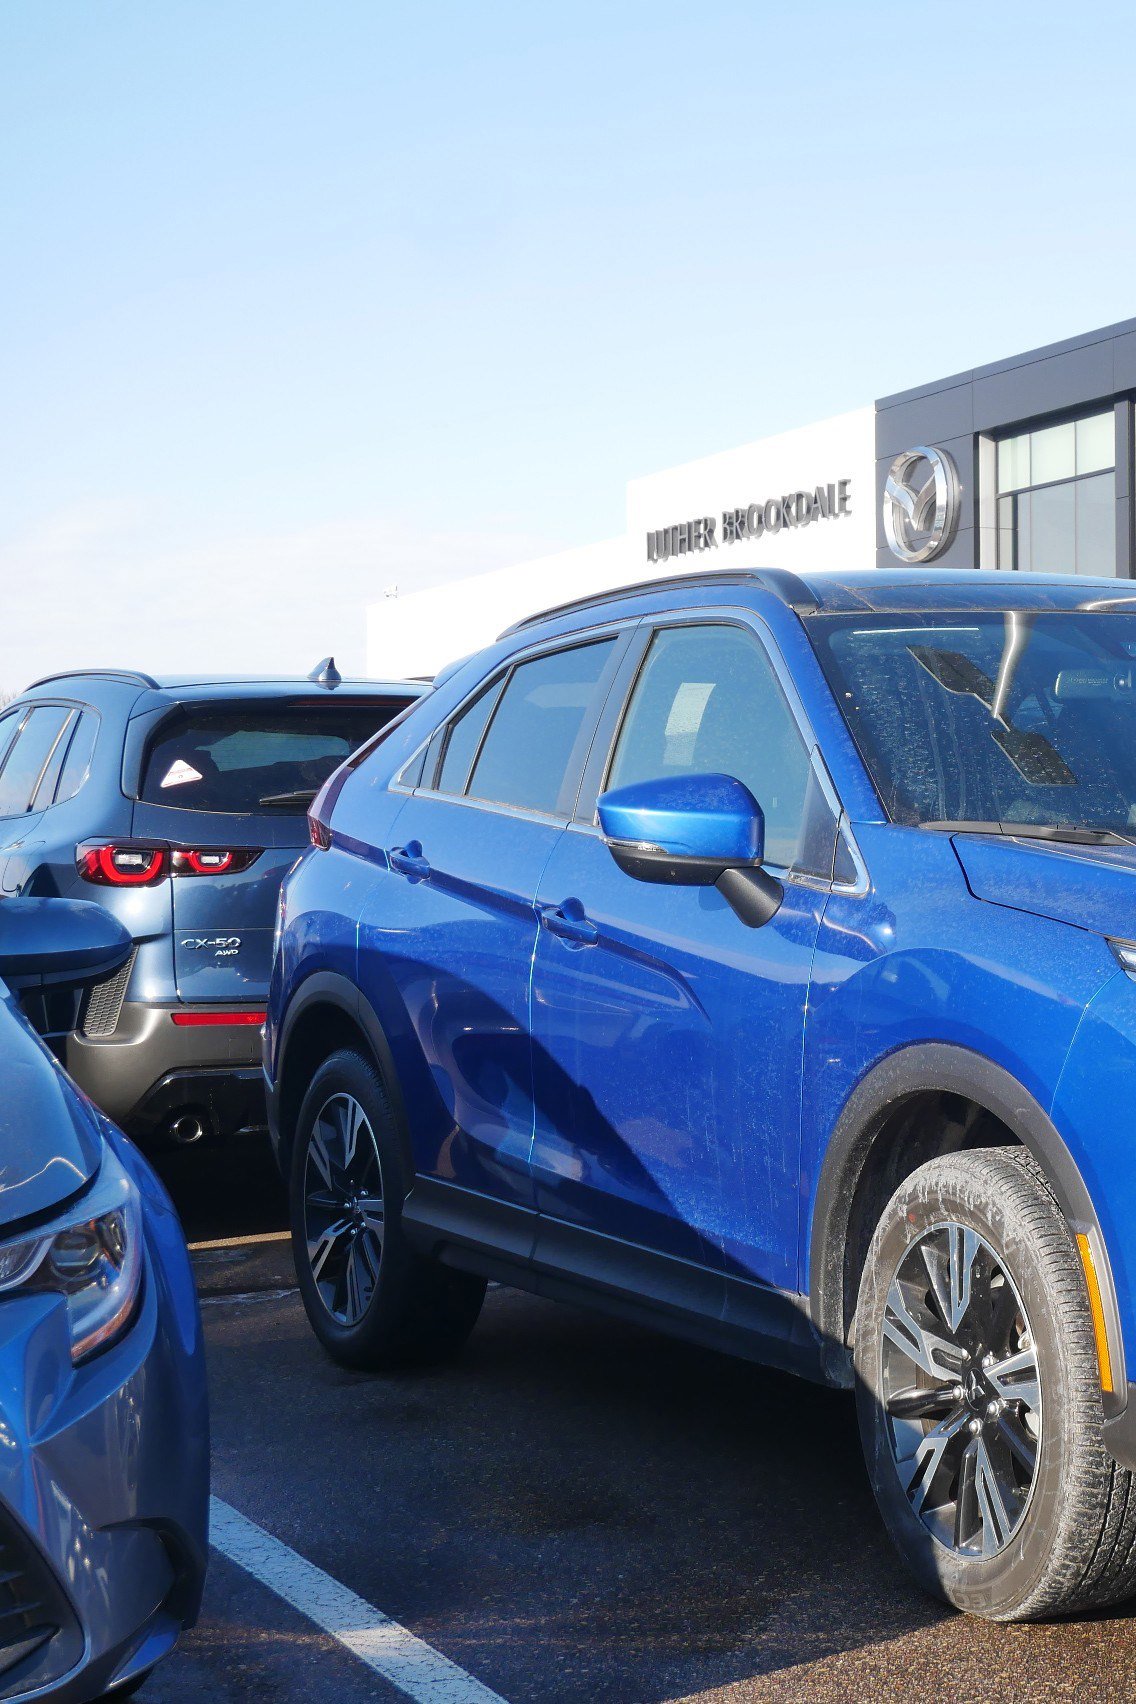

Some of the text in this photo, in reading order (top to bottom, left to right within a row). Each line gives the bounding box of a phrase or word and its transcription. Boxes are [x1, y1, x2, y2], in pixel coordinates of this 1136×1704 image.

[646, 479, 852, 563] LUTHER BROOKDALE
[181, 937, 242, 949] CX-50
